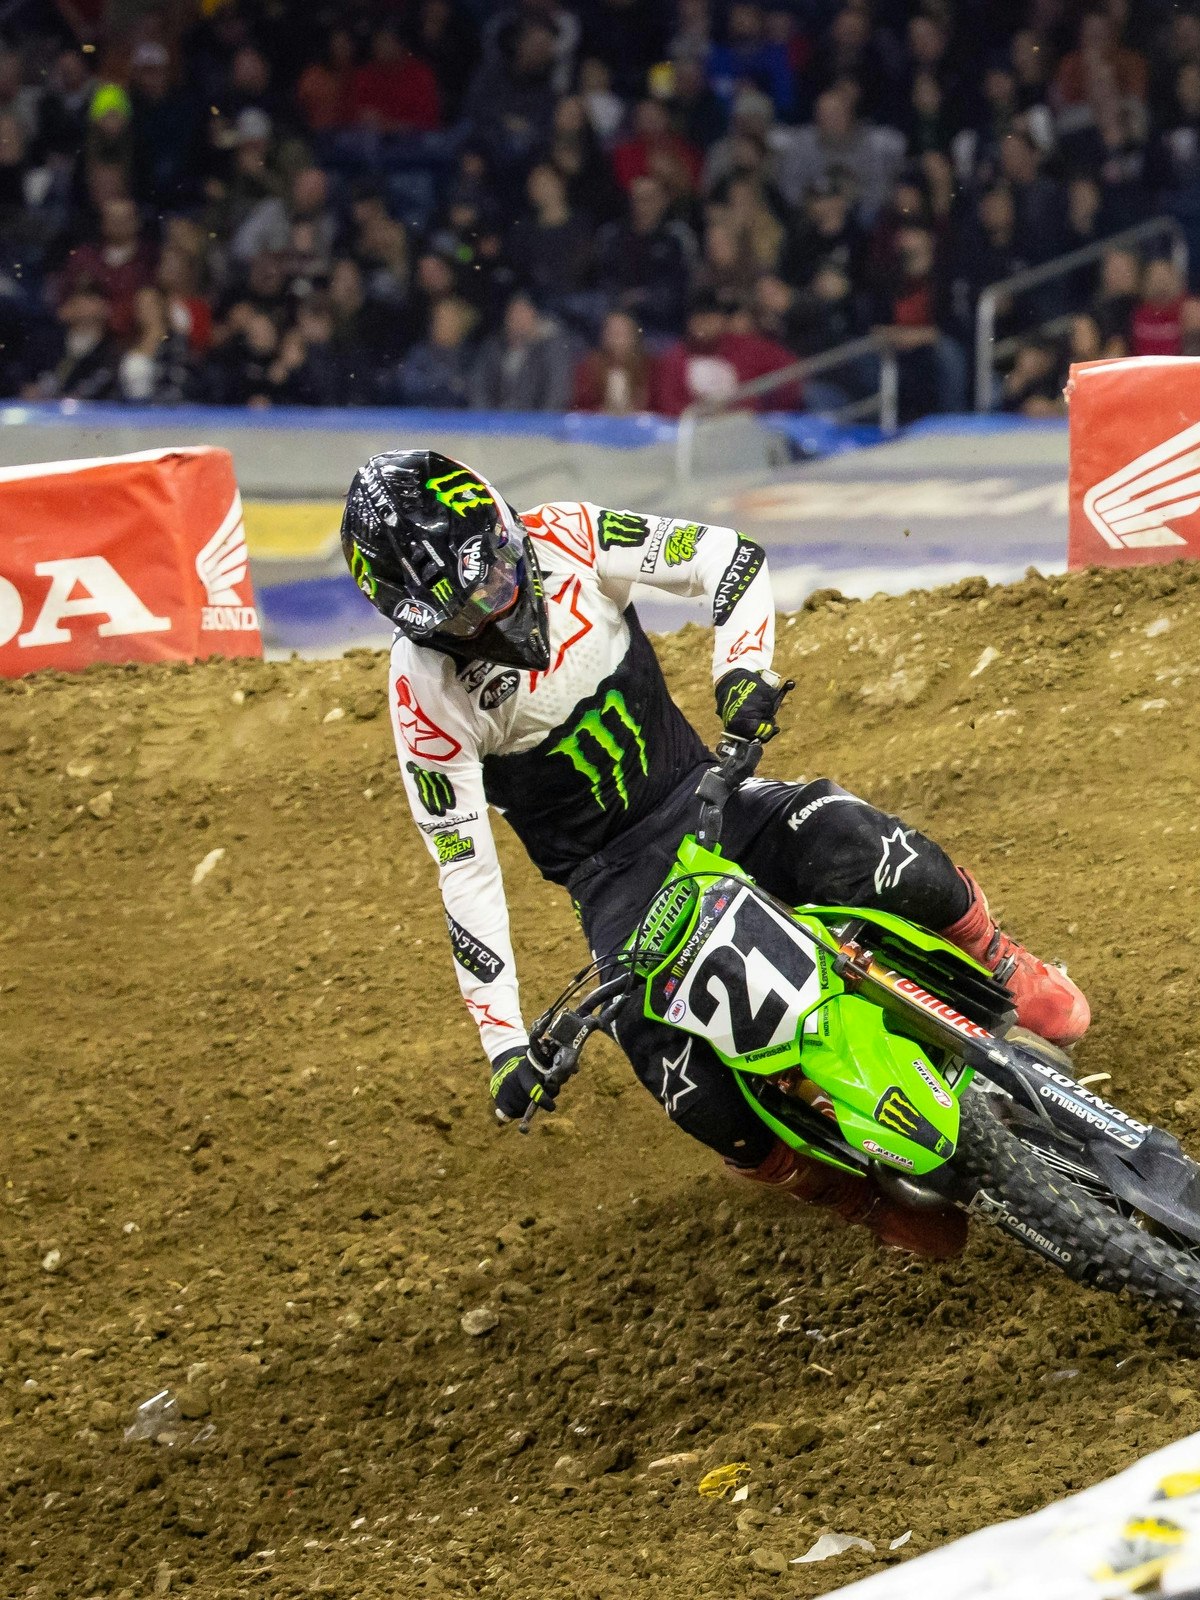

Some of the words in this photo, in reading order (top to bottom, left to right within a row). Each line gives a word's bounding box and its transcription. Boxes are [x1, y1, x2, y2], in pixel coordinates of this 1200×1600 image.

[446, 914, 500, 974] ONSTER
[677, 915, 714, 967] MONSTER
[688, 893, 816, 1055] 21
[744, 1042, 792, 1063] Kawasaki
[1032, 1063, 1152, 1135] DUNLOP
[1040, 1086, 1108, 1134] CARRILLO
[1007, 1215, 1072, 1262] CARRILLO
